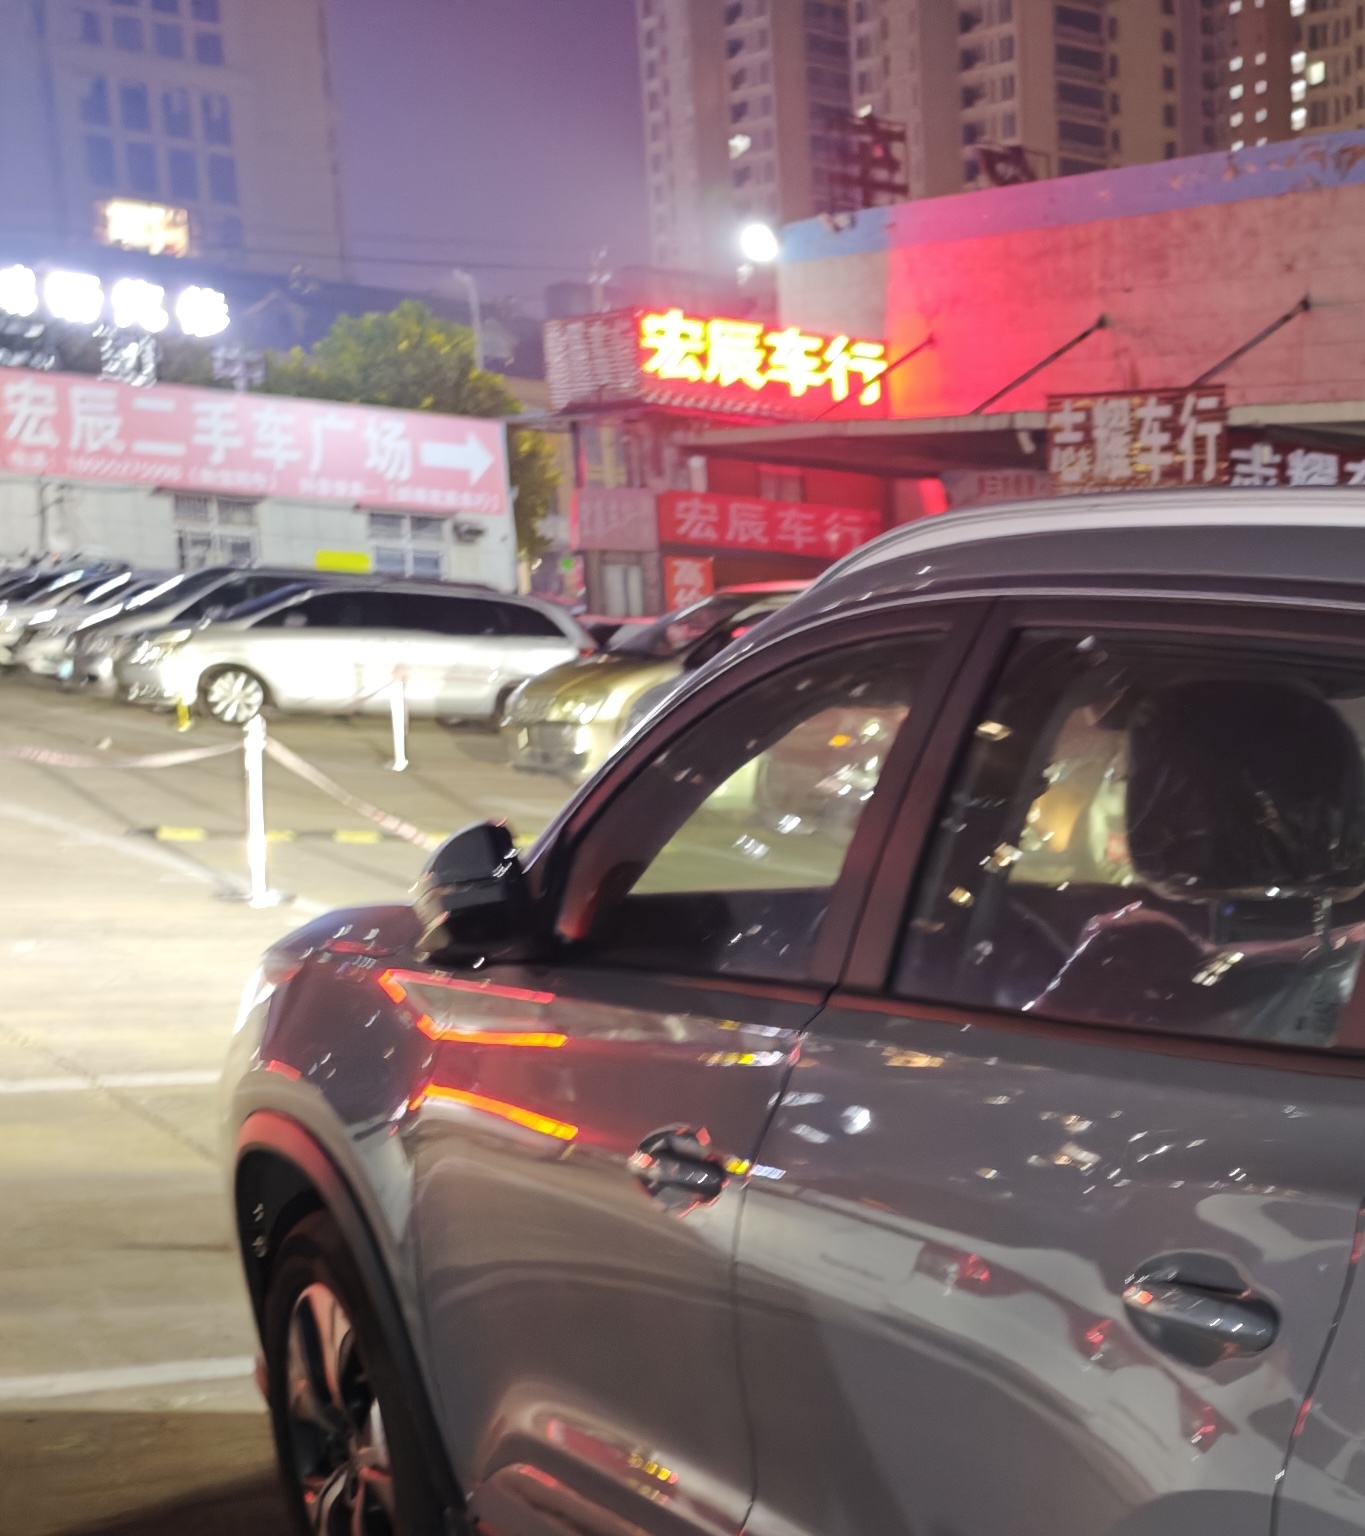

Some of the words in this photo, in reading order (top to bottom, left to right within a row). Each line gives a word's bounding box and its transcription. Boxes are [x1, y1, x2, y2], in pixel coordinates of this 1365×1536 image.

[640, 308, 888, 407] 宏辰车行
[3, 374, 414, 482] 宏辰二手车广场
[675, 496, 866, 553] 宏辰车行
